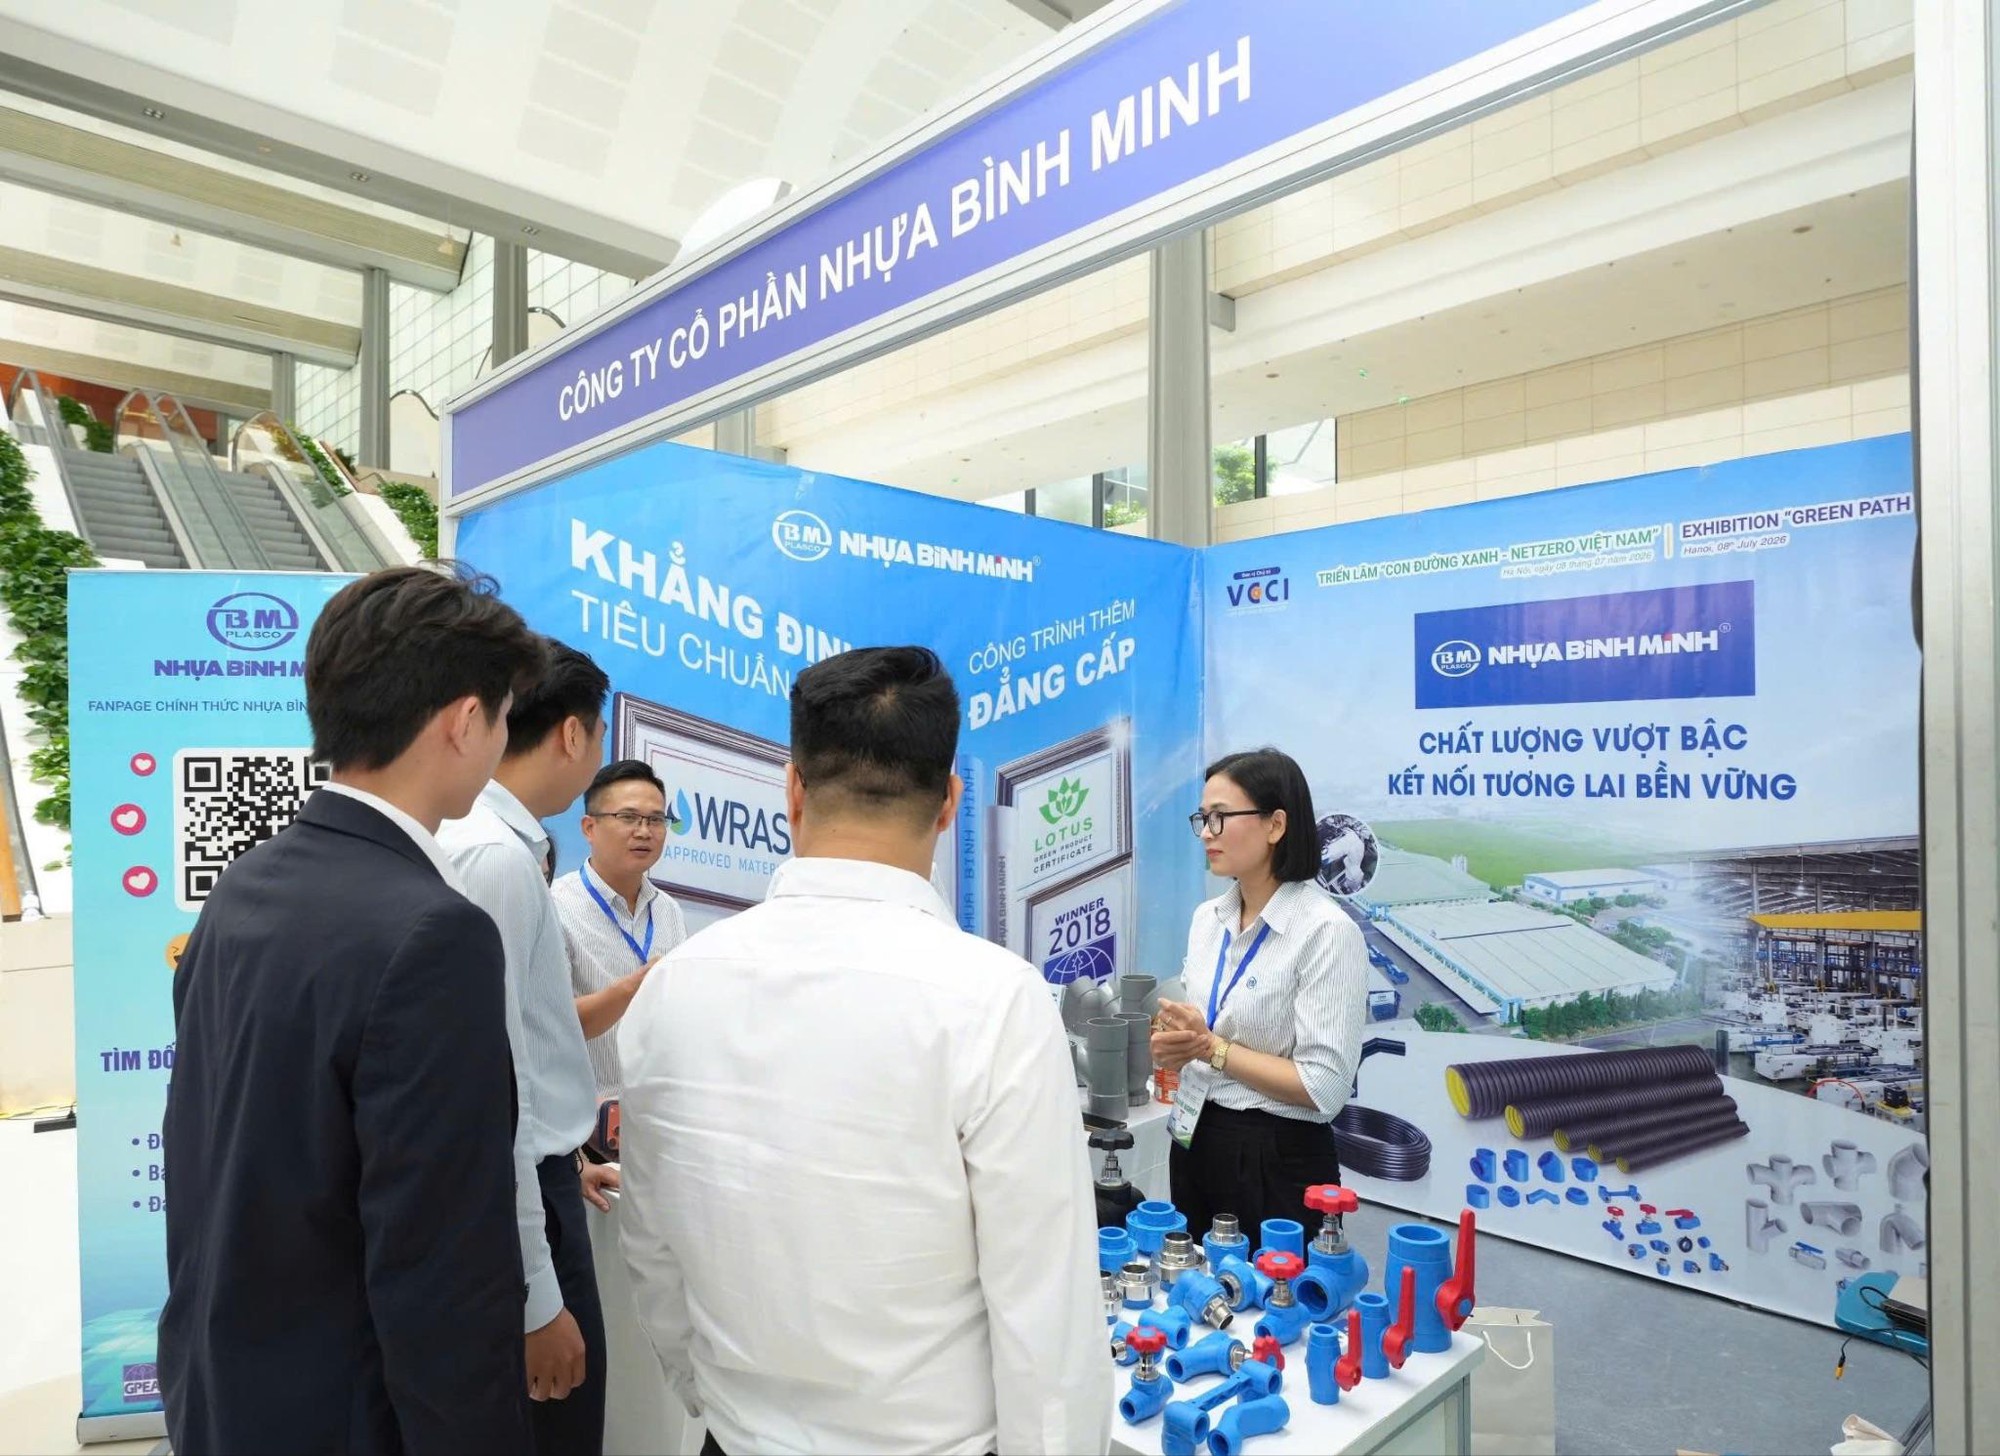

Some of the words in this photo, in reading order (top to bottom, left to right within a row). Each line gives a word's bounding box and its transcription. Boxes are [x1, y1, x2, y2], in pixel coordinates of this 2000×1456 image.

[559, 360, 623, 421] CÔNG
[630, 338, 662, 388] TY
[669, 308, 709, 369] CỔ
[719, 264, 807, 348] PHẦN
[819, 202, 939, 300] NHỰA
[951, 129, 1070, 239] BÌNH
[1091, 35, 1251, 171] MINH
[1682, 513, 1779, 538] EXHIBITION
[1859, 495, 1911, 516] PATH
[840, 530, 914, 568] NHỰA
[1318, 565, 1350, 584] TRIỂN
[1413, 552, 1459, 572] ĐƯỜNG
[1462, 550, 1499, 567] XANH
[1511, 540, 1575, 560] NETZERO
[1579, 532, 1612, 551] VIỆT
[1760, 535, 1787, 546] 2026
[571, 518, 763, 639] KHẲNG
[775, 611, 852, 667] ĐỊN
[1226, 578, 1289, 606] VCCI
[571, 589, 665, 657] TIÊU
[679, 632, 789, 701] CHUẨN
[969, 636, 1026, 674] CÔNG
[1031, 617, 1085, 651] TRÌNH
[1089, 598, 1135, 631] THÊM
[154, 659, 224, 681] NHỰA
[1488, 643, 1564, 669] NHỰA
[968, 664, 1065, 731] ĐẲNG
[1076, 631, 1136, 686] CẤP
[88, 700, 151, 712] FANPAGE
[156, 698, 198, 712] CHÍNH
[202, 697, 239, 712] THỨC
[243, 699, 282, 714] NHỰA
[286, 698, 308, 712] BÌN
[1419, 721, 1484, 755] CHẤT
[1492, 727, 1584, 760] LƯỢNG
[1593, 723, 1670, 758] VƯỢT
[1681, 717, 1748, 758] BẬC
[1388, 764, 1425, 796] KẾT
[1432, 764, 1475, 796] NỐI
[1483, 771, 1575, 797] TƯƠNG
[1585, 773, 1625, 798] LAI
[1636, 760, 1691, 799] BỀN
[1701, 767, 1797, 800] VỮNG
[694, 792, 791, 855] WRAS
[1035, 816, 1093, 852] LOTUS
[1060, 833, 1092, 851] PRODUCT
[664, 845, 731, 869] APPROVED
[739, 858, 778, 876] MATER
[1033, 843, 1093, 874] CERTIFICATE
[1054, 897, 1105, 926] WINNER
[1049, 908, 1110, 955] 2018
[100, 1047, 141, 1072] TÌM
